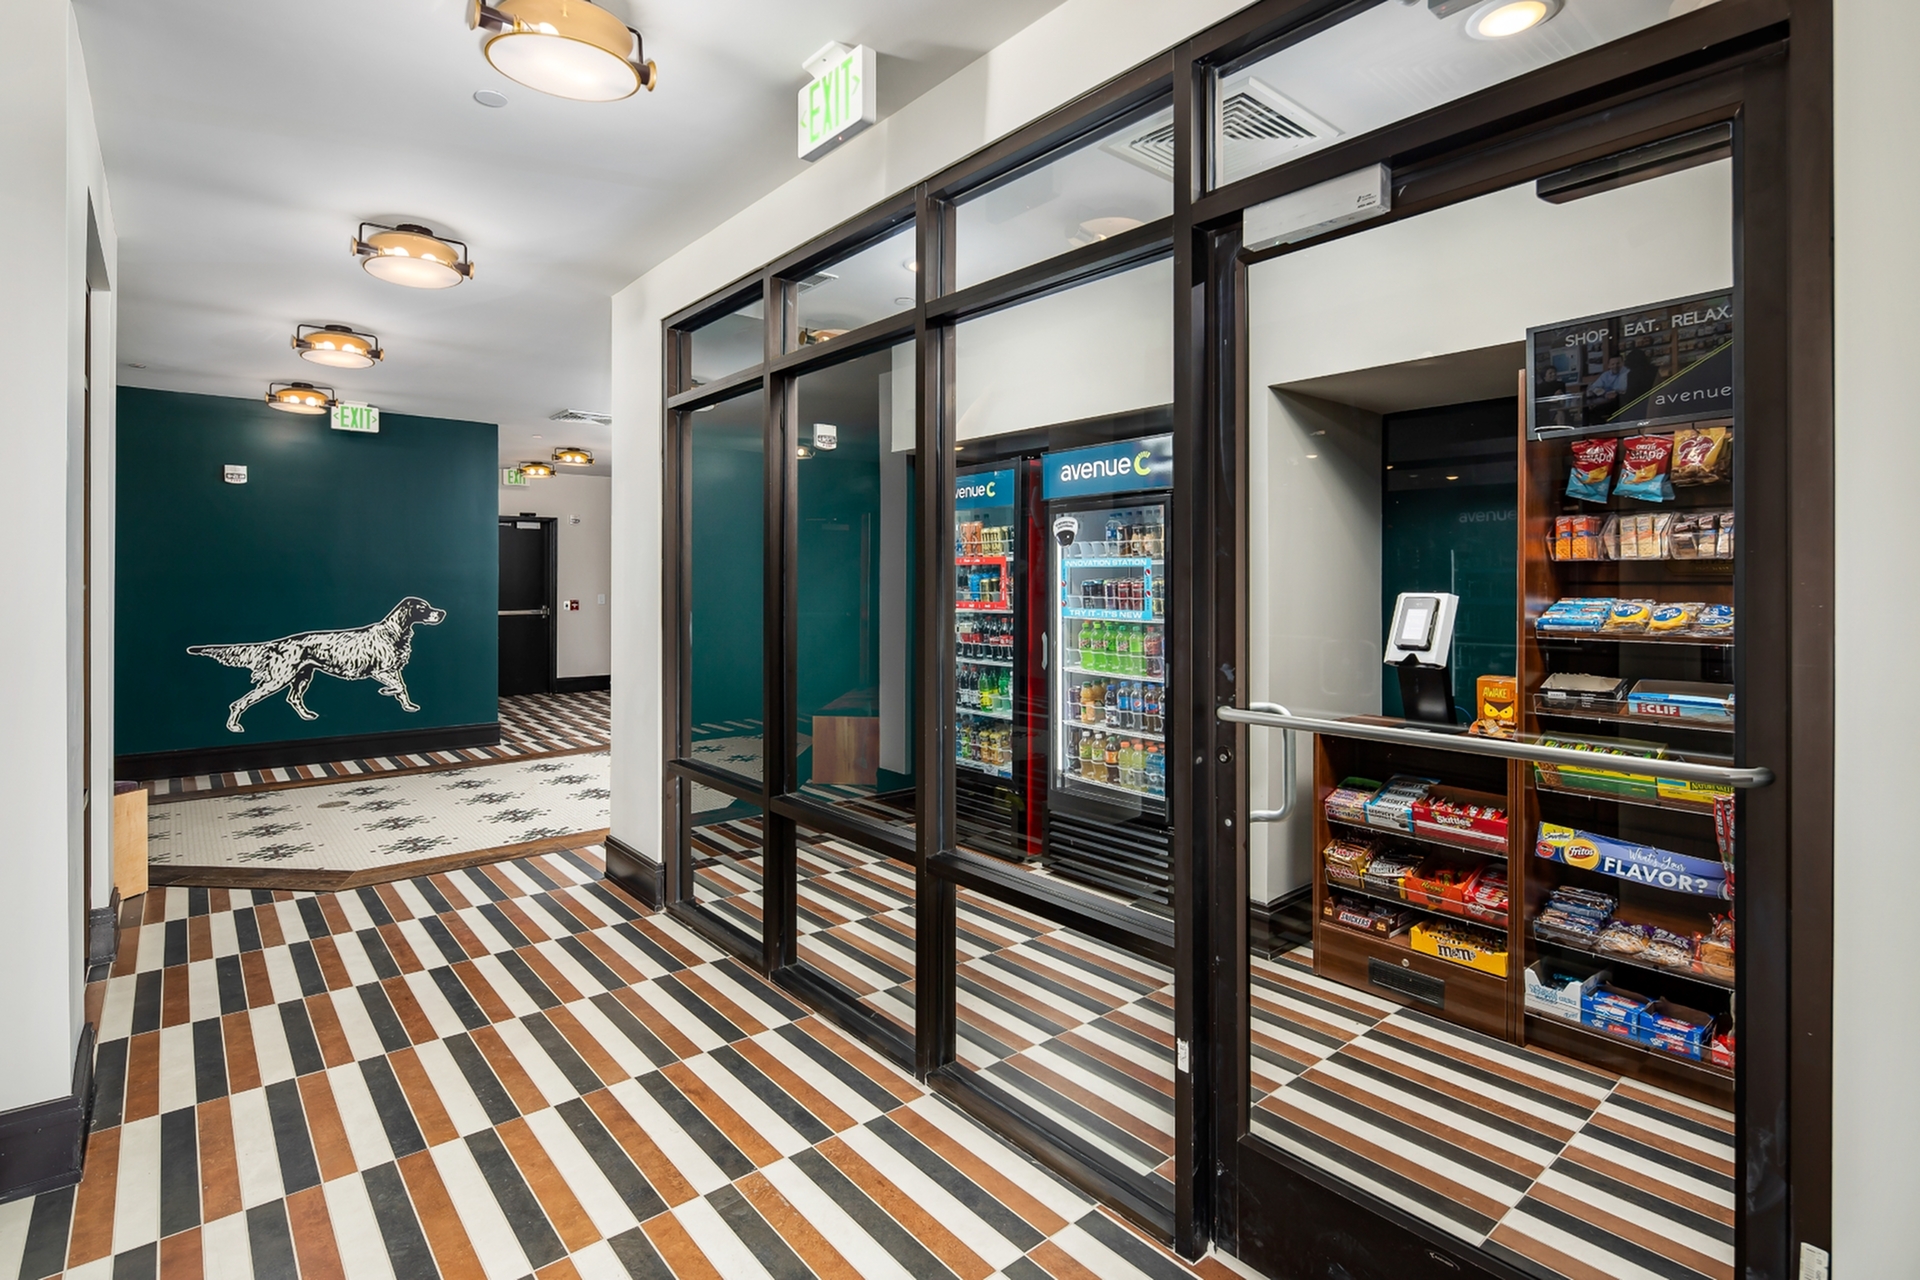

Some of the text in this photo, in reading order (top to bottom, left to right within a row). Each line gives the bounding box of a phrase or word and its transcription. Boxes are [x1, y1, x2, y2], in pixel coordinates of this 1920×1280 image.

[809, 56, 853, 144] EXIT
[1565, 305, 1733, 348] SHOP. EAT. RELAX.
[1654, 385, 1732, 405] avenue
[340, 406, 373, 429] EXIT
[1060, 457, 1131, 482] avenue
[955, 485, 986, 499] venue
[1459, 509, 1517, 524] avenue
[1065, 558, 1147, 567] INNOVATION STATION
[1119, 610, 1143, 618] NEW
[1483, 686, 1507, 698] AWAKE
[1646, 704, 1677, 715] CLIF
[1716, 785, 1735, 793] VALLE
[1436, 815, 1472, 827] Skittles
[1568, 845, 1595, 857] Fritos
[1628, 847, 1687, 873] What's Your
[1603, 856, 1709, 894] FLAVOR?
[1340, 912, 1370, 927] SNICKERS
